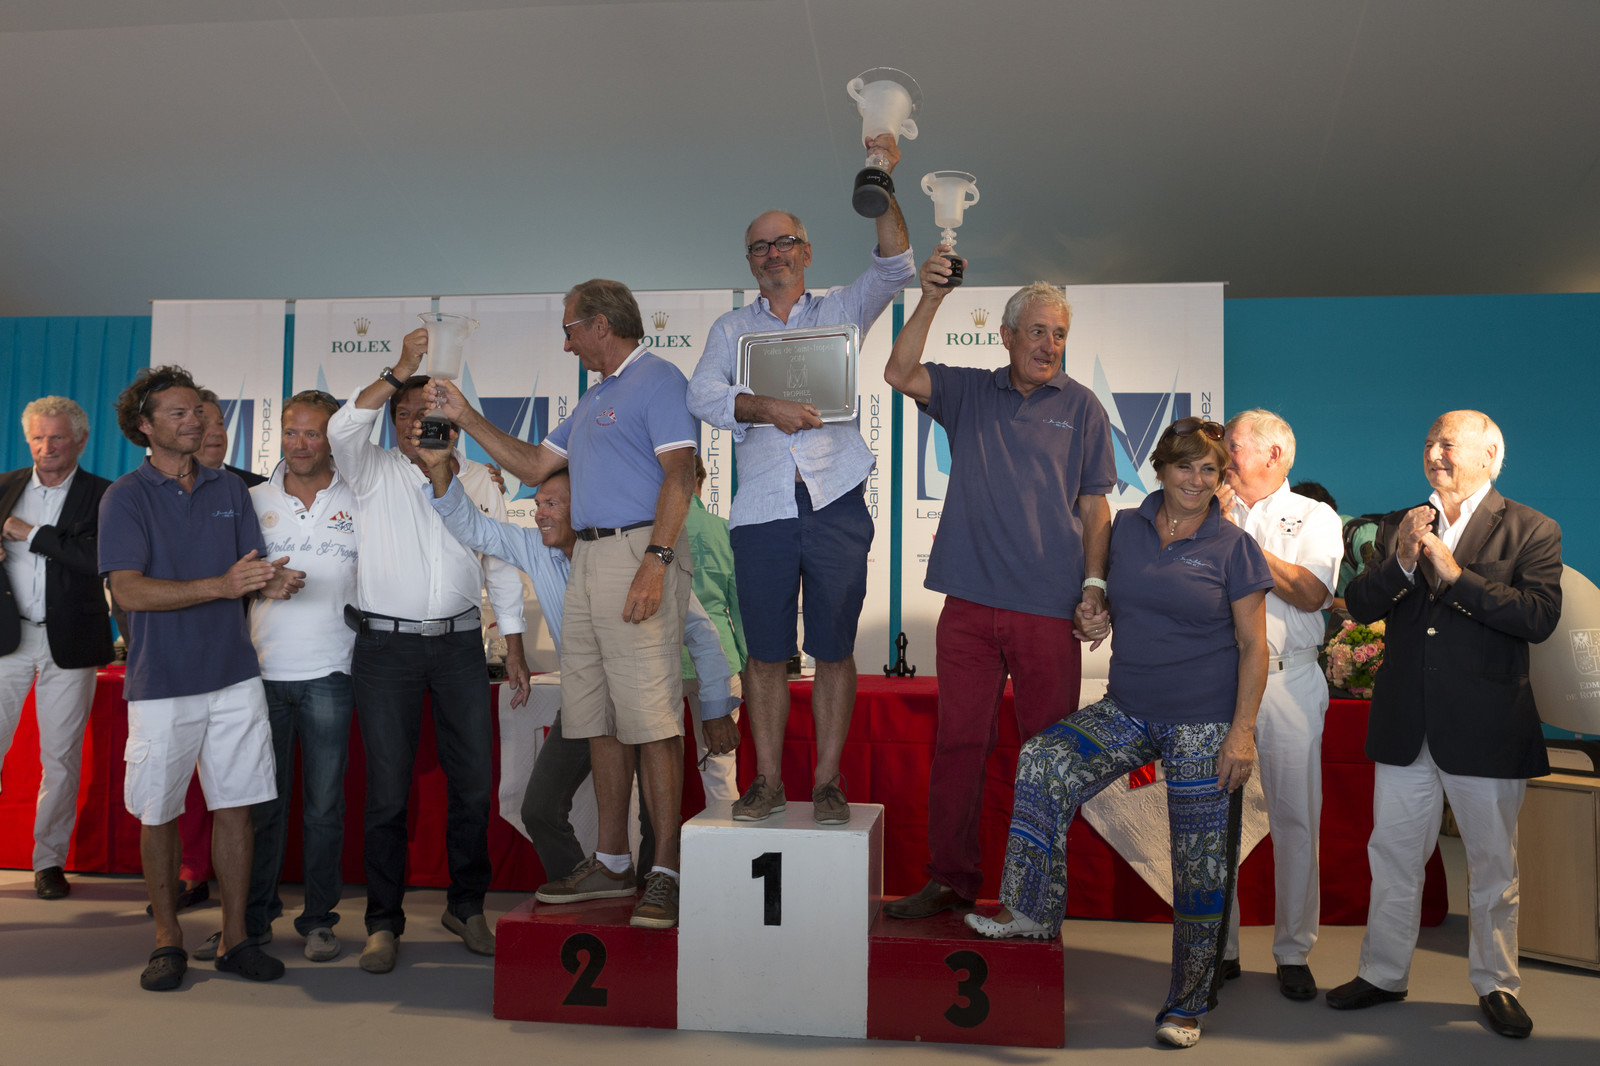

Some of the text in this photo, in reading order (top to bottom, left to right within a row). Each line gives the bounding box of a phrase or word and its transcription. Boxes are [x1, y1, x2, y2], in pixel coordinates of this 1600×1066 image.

[331, 340, 392, 353] ROLEX
[641, 335, 692, 348] OLEX
[946, 332, 1004, 346] ROLE
[258, 398, 273, 477] t-Tropez
[706, 427, 720, 516] Saint-Tro
[1579, 681, 1600, 689] EDM
[751, 853, 782, 926] 1
[560, 933, 607, 1007] 2
[943, 950, 990, 1028] 3
